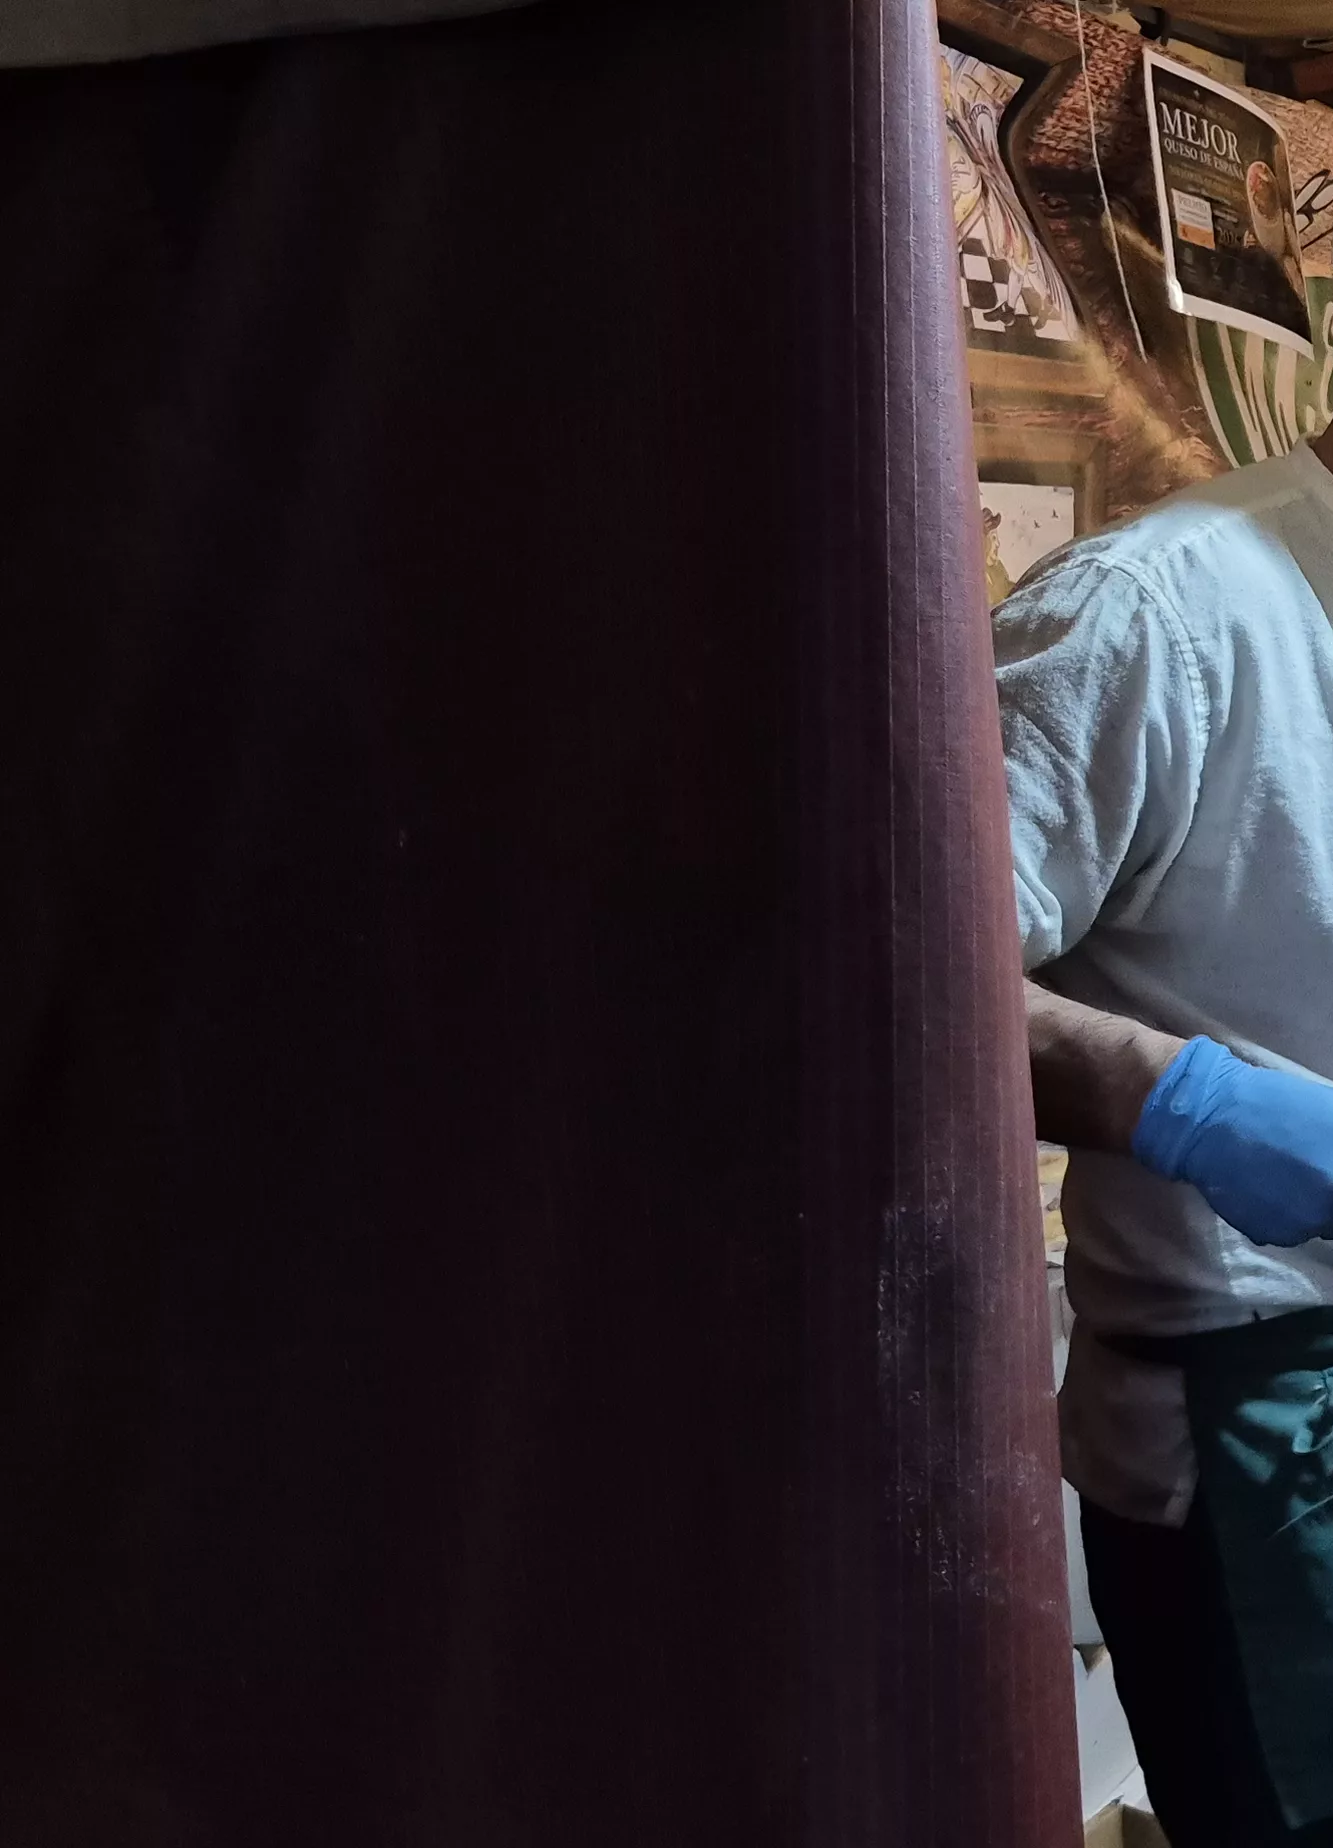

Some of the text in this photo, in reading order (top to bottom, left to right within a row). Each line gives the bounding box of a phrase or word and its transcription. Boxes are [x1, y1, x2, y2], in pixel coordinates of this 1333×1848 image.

[1160, 102, 1242, 164] MEJOR
[1164, 137, 1199, 161] QUESO
[1199, 150, 1213, 166] DE
[1213, 154, 1245, 181] ESPAÑA
